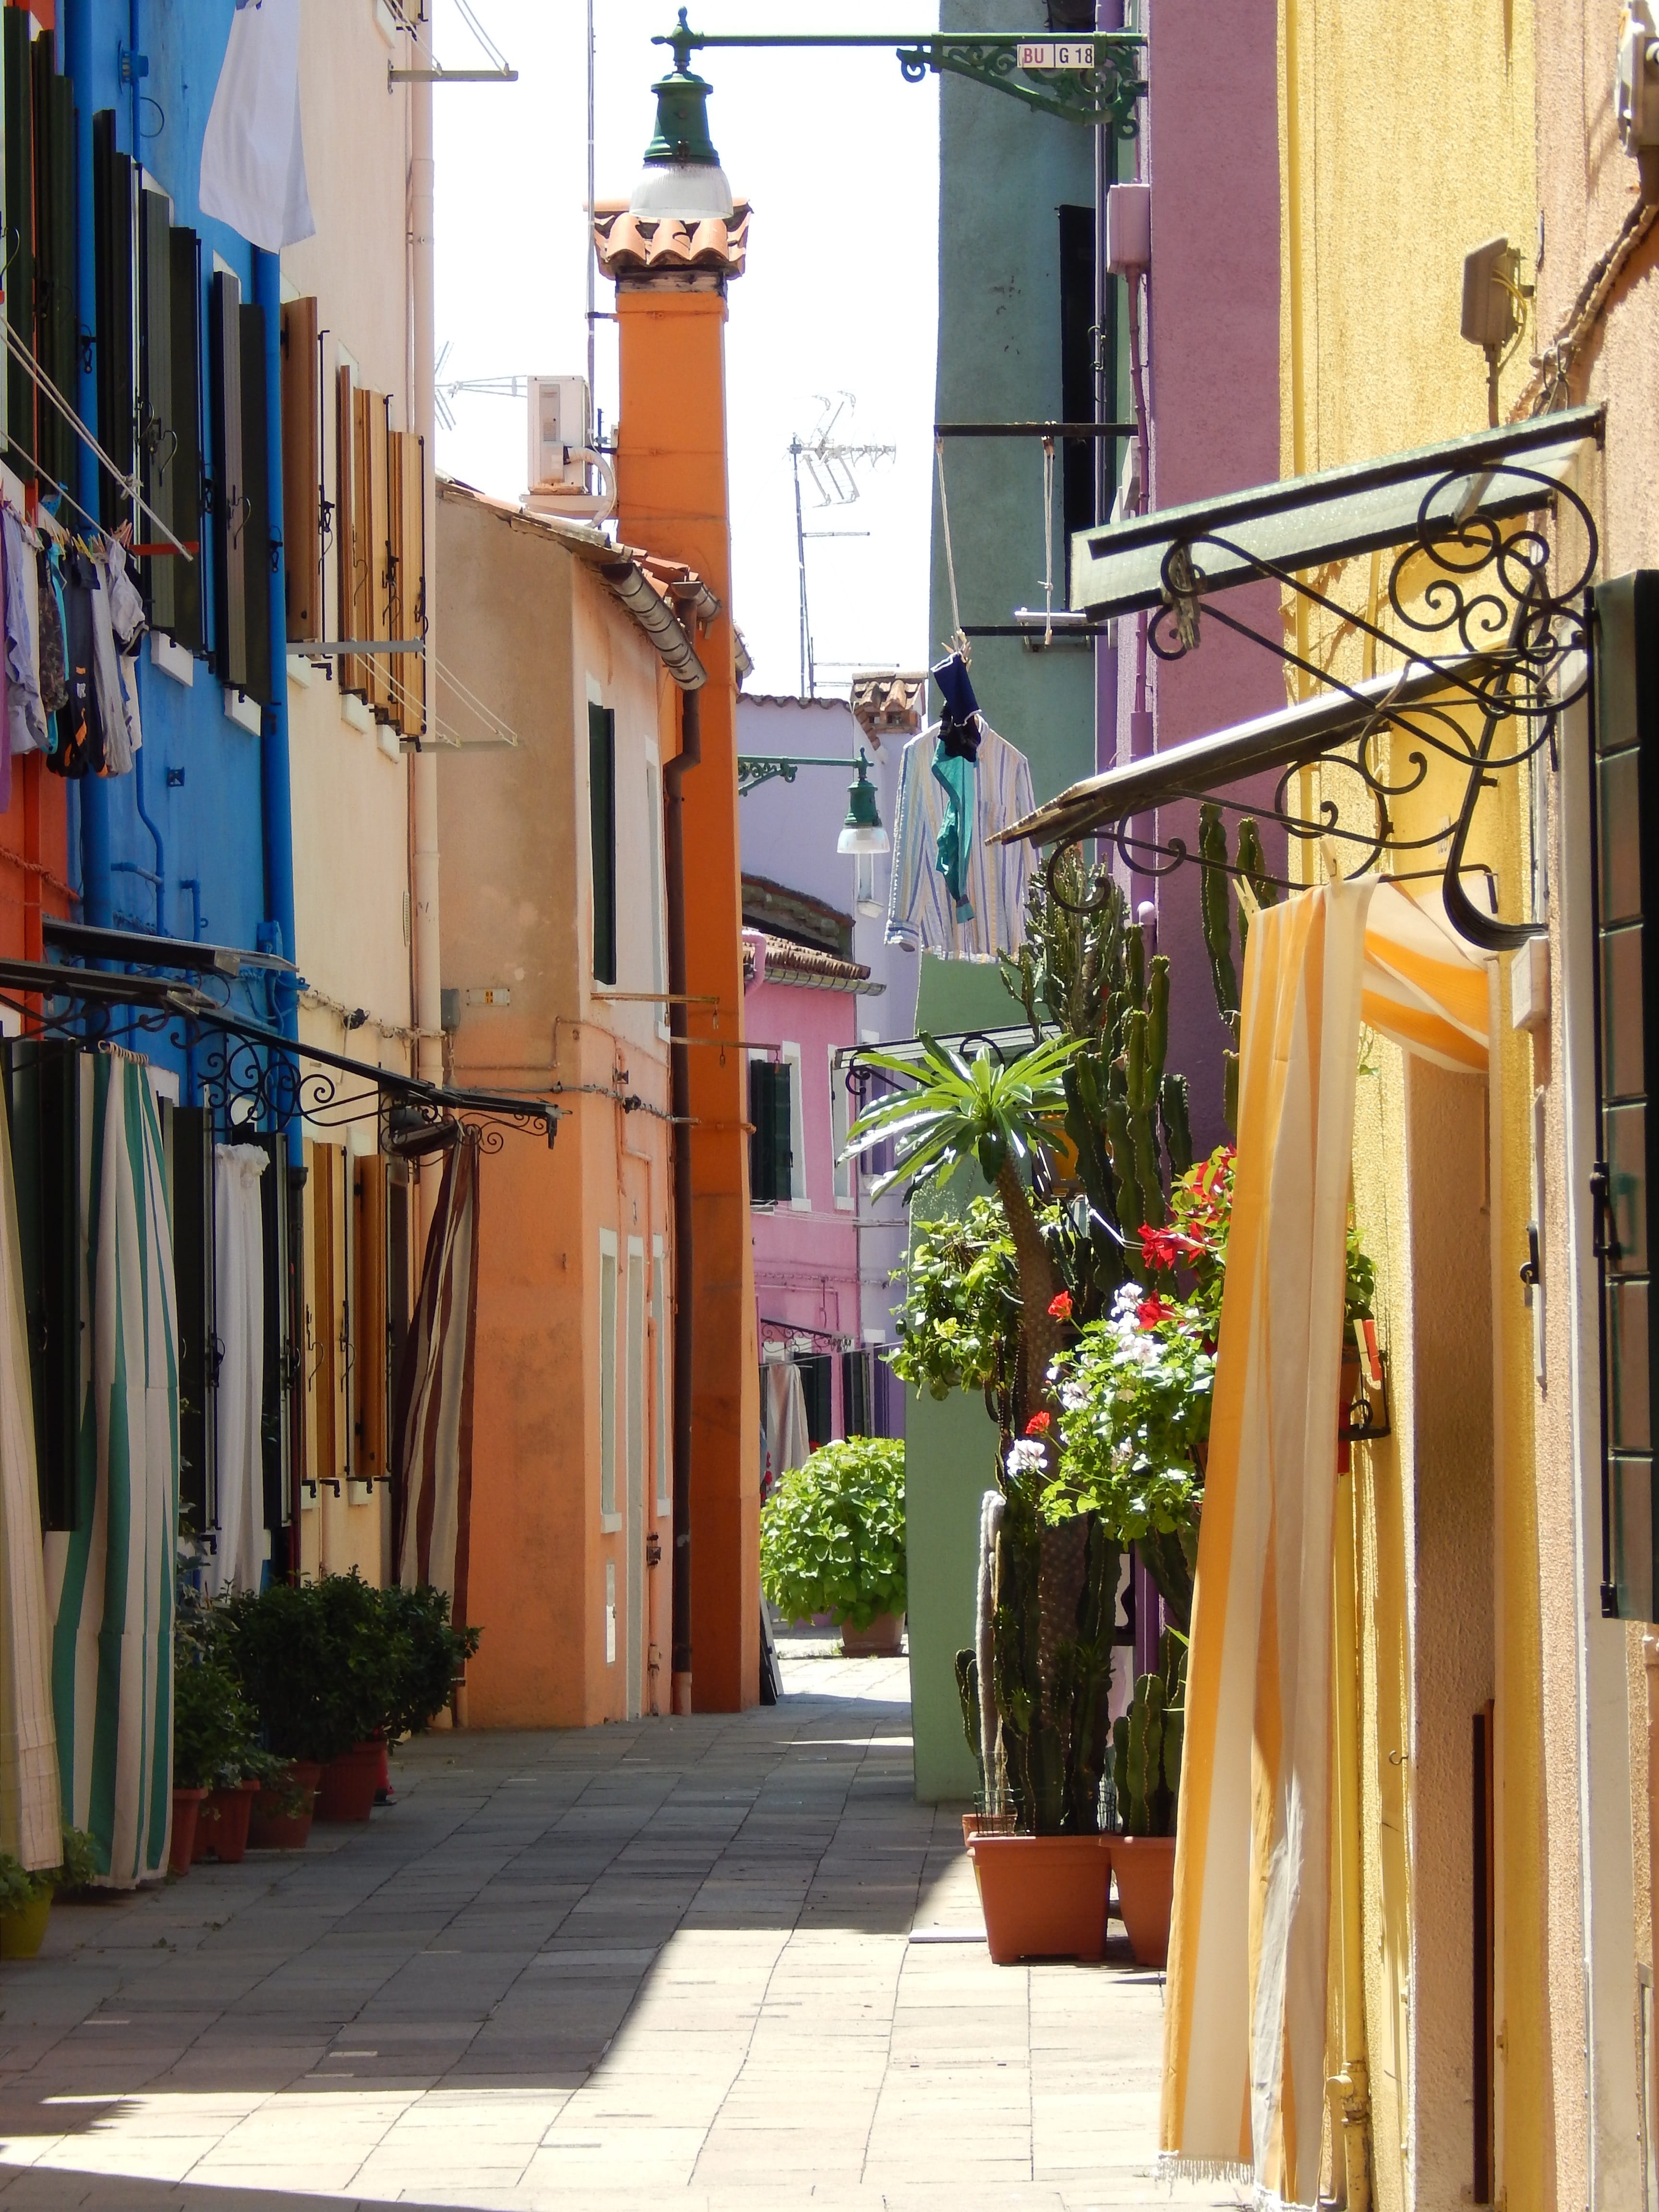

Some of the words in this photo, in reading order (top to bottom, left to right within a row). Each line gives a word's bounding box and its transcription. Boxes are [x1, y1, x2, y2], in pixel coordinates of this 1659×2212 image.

[1023, 48, 1044, 64] BU
[1059, 47, 1069, 63] G
[1075, 48, 1093, 63] 18
